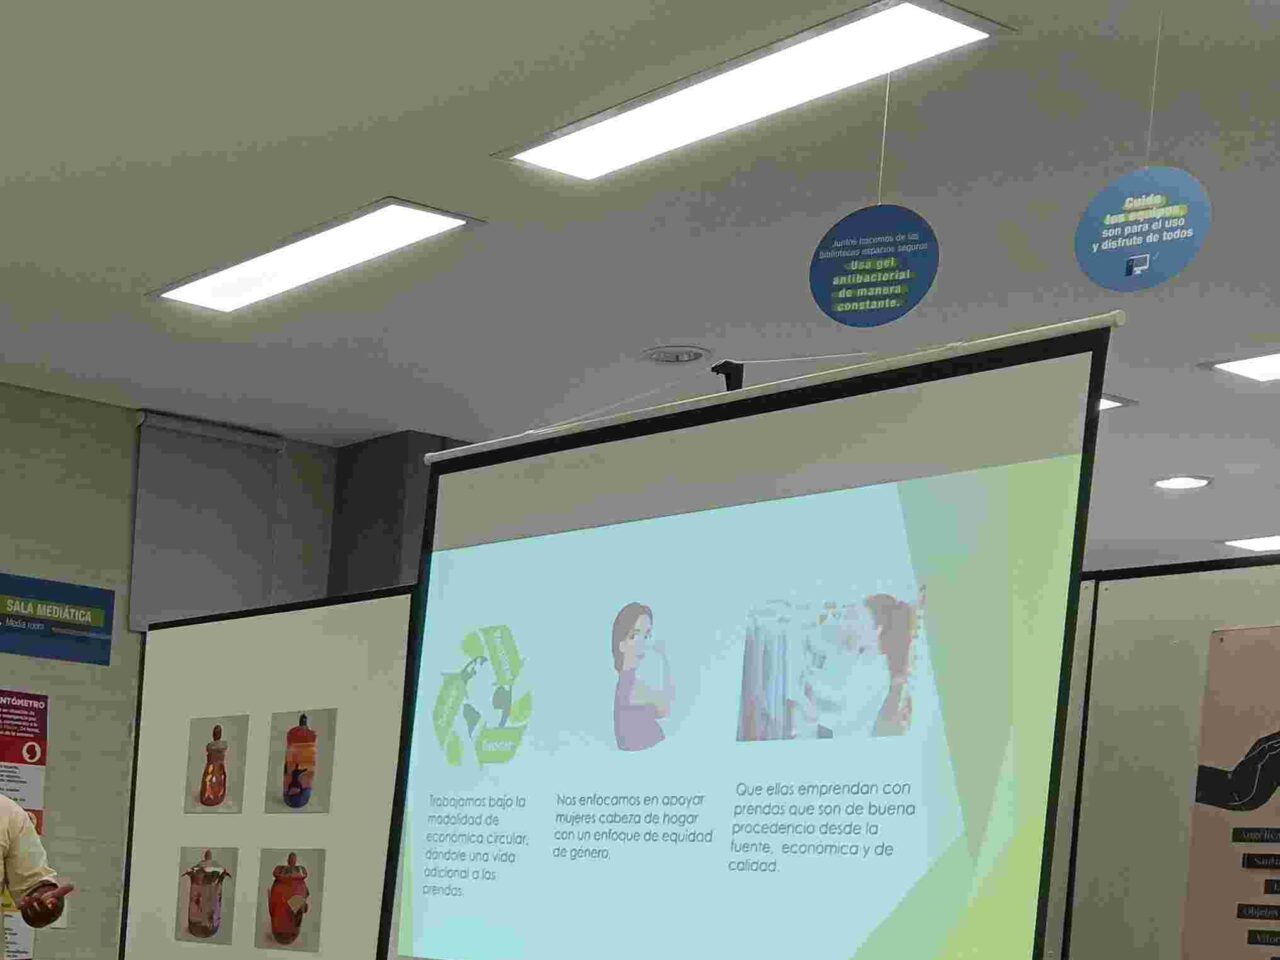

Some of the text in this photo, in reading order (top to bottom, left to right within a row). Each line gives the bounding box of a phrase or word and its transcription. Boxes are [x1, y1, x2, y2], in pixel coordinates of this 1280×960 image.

[1102, 218, 1185, 238] son para el uso
[1092, 228, 1193, 253] y disfrute de todos
[876, 257, 897, 270] gel
[832, 269, 911, 286] antibacterial
[838, 285, 901, 298] de manera
[837, 299, 901, 312] constante.
[6, 599, 92, 623] SALA MEDIÁTICA
[735, 781, 911, 797] Que ellas emprendan con
[488, 794, 513, 811] bajo
[516, 795, 526, 808] la
[557, 793, 706, 808] Nos enfocamos en apoyar
[733, 801, 916, 818] prendas que son de buena
[485, 814, 500, 826] de
[555, 811, 699, 827] mujeres cabeza de hogar
[554, 828, 714, 844] con un enfoque de equidad
[732, 821, 879, 836] procedencia desde la
[469, 851, 489, 862] una
[492, 848, 516, 863] vida
[552, 846, 568, 858] de
[863, 845, 871, 858] y
[874, 841, 894, 856] de
[423, 866, 469, 879] adicional
[482, 868, 497, 880] las
